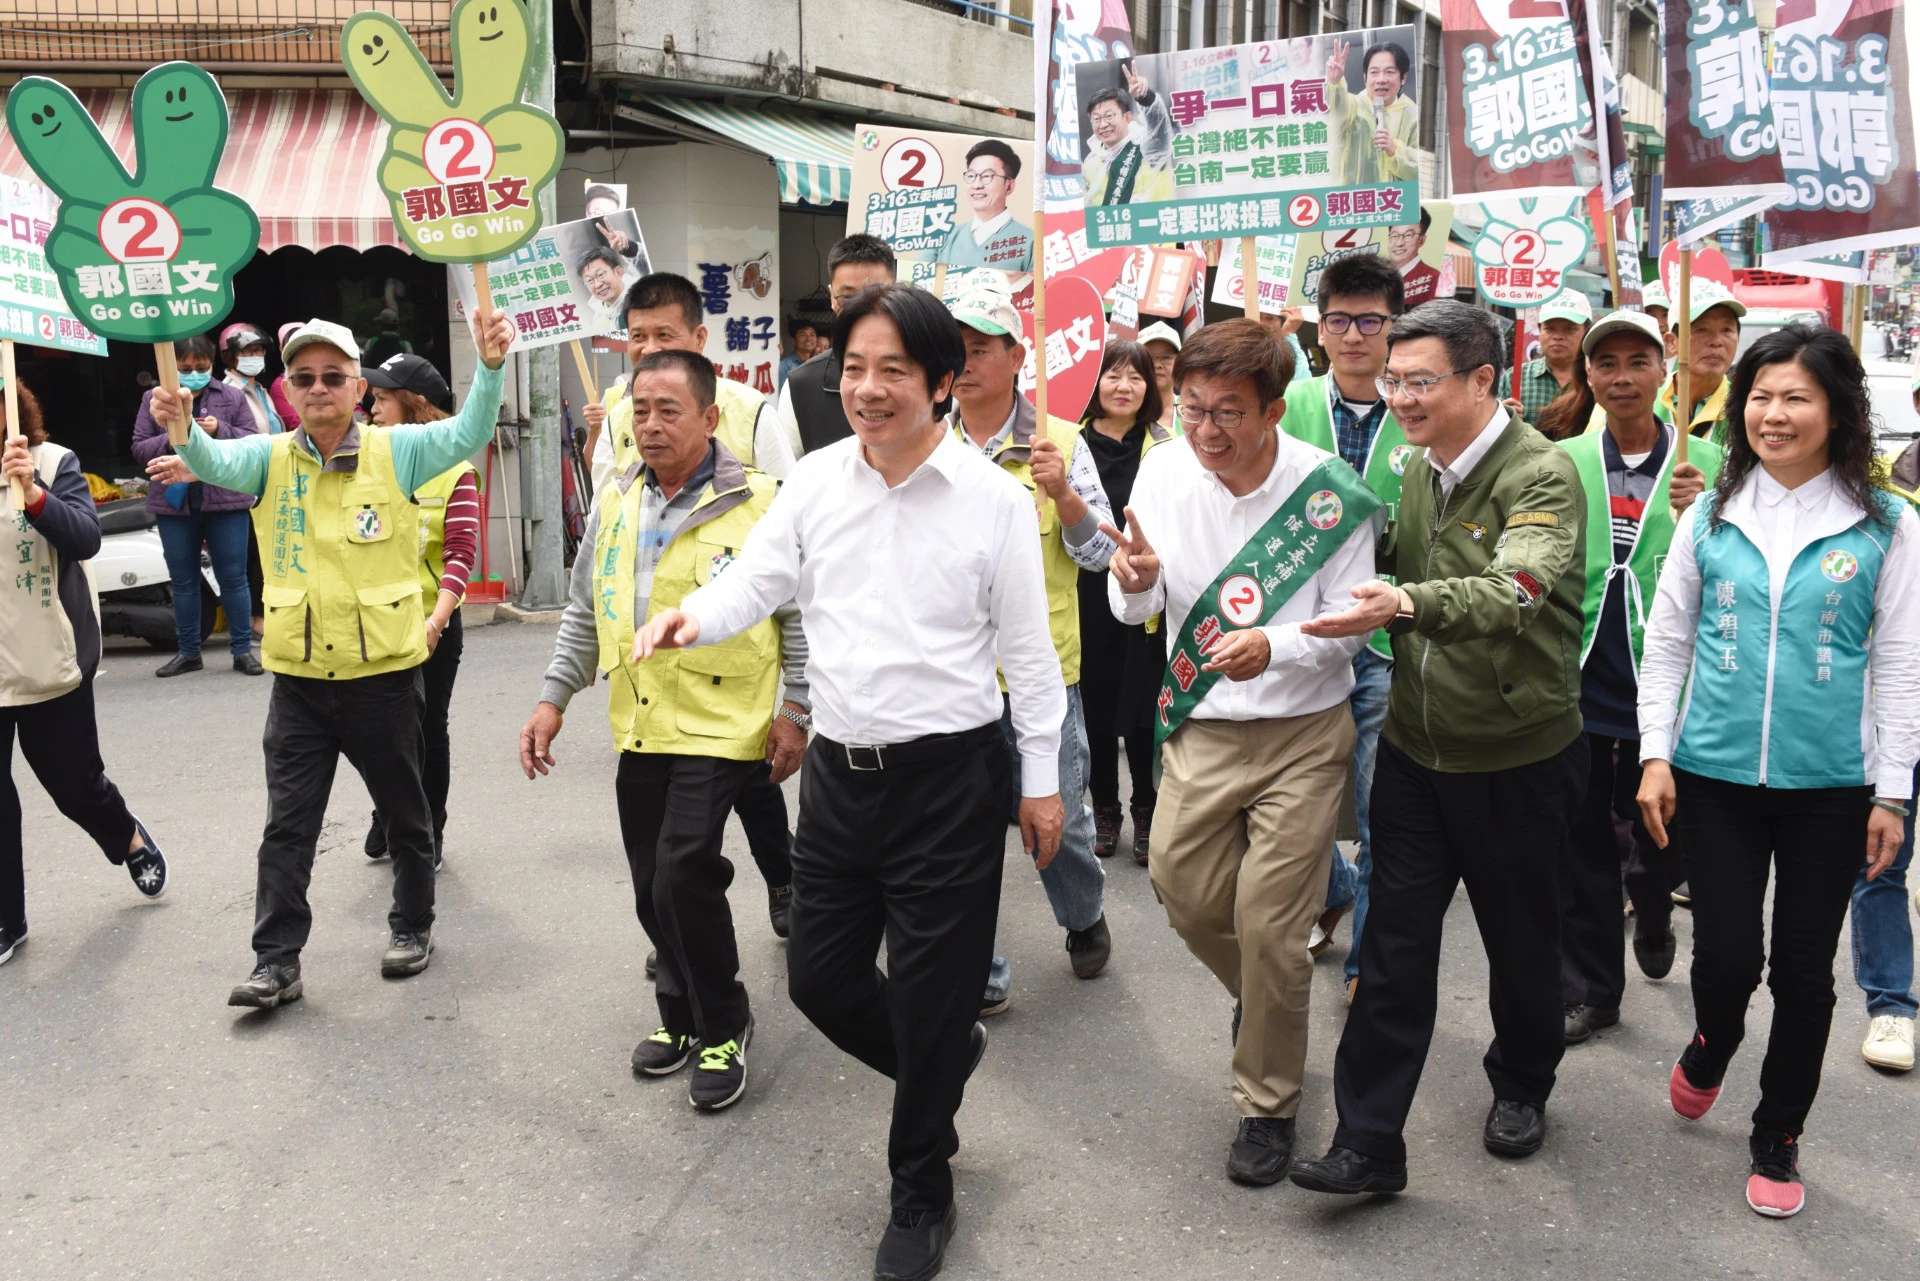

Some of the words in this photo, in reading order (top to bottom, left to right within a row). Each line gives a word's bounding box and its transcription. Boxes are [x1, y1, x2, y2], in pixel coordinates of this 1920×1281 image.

[1259, 45, 1271, 64] 2
[1171, 79, 1328, 126] 爭一口氣
[1469, 58, 1592, 151] 郭國
[440, 127, 481, 178] 2
[1172, 120, 1328, 158] 台灣絕不能輸
[899, 149, 926, 188] 2
[1173, 150, 1330, 187] 台南一定要贏
[403, 177, 531, 222] 郭國文
[1297, 199, 1313, 221] 2
[1327, 189, 1402, 217] 郭國文
[417, 227, 444, 243] Go
[452, 222, 478, 239] Go
[485, 217, 524, 235] Win
[867, 203, 955, 241] 郭國文
[1096, 208, 1131, 223] 3.16
[1139, 200, 1281, 236] 一定要出來投票
[118, 207, 165, 258] 2
[991, 235, 1028, 250] 台大碩士
[1098, 223, 1132, 242] 懇請
[989, 249, 1026, 263] 成大博士
[1512, 235, 1534, 264] 2
[75, 260, 219, 299] 郭國文
[486, 262, 566, 292] 灣絕不能輸
[1233, 279, 1244, 295] 2
[1484, 267, 1560, 288] 郭國文
[91, 303, 121, 320] Go
[130, 302, 160, 318] Go
[167, 299, 212, 316] Win
[492, 279, 573, 309] 南一定要贏
[1510, 290, 1522, 298] Go
[1525, 291, 1543, 299] Win
[42, 317, 53, 337] 2
[515, 303, 580, 333] 郭國文
[726, 316, 776, 352] 舖子
[713, 361, 775, 394] 地瓜
[290, 468, 310, 574] 郭國文
[1244, 513, 1304, 579] 候選人
[1262, 533, 1319, 596] 立委補選
[1228, 586, 1255, 616] 2
[1715, 580, 1739, 672] 陳碧玉
[1806, 590, 1842, 682] 台南市議員
